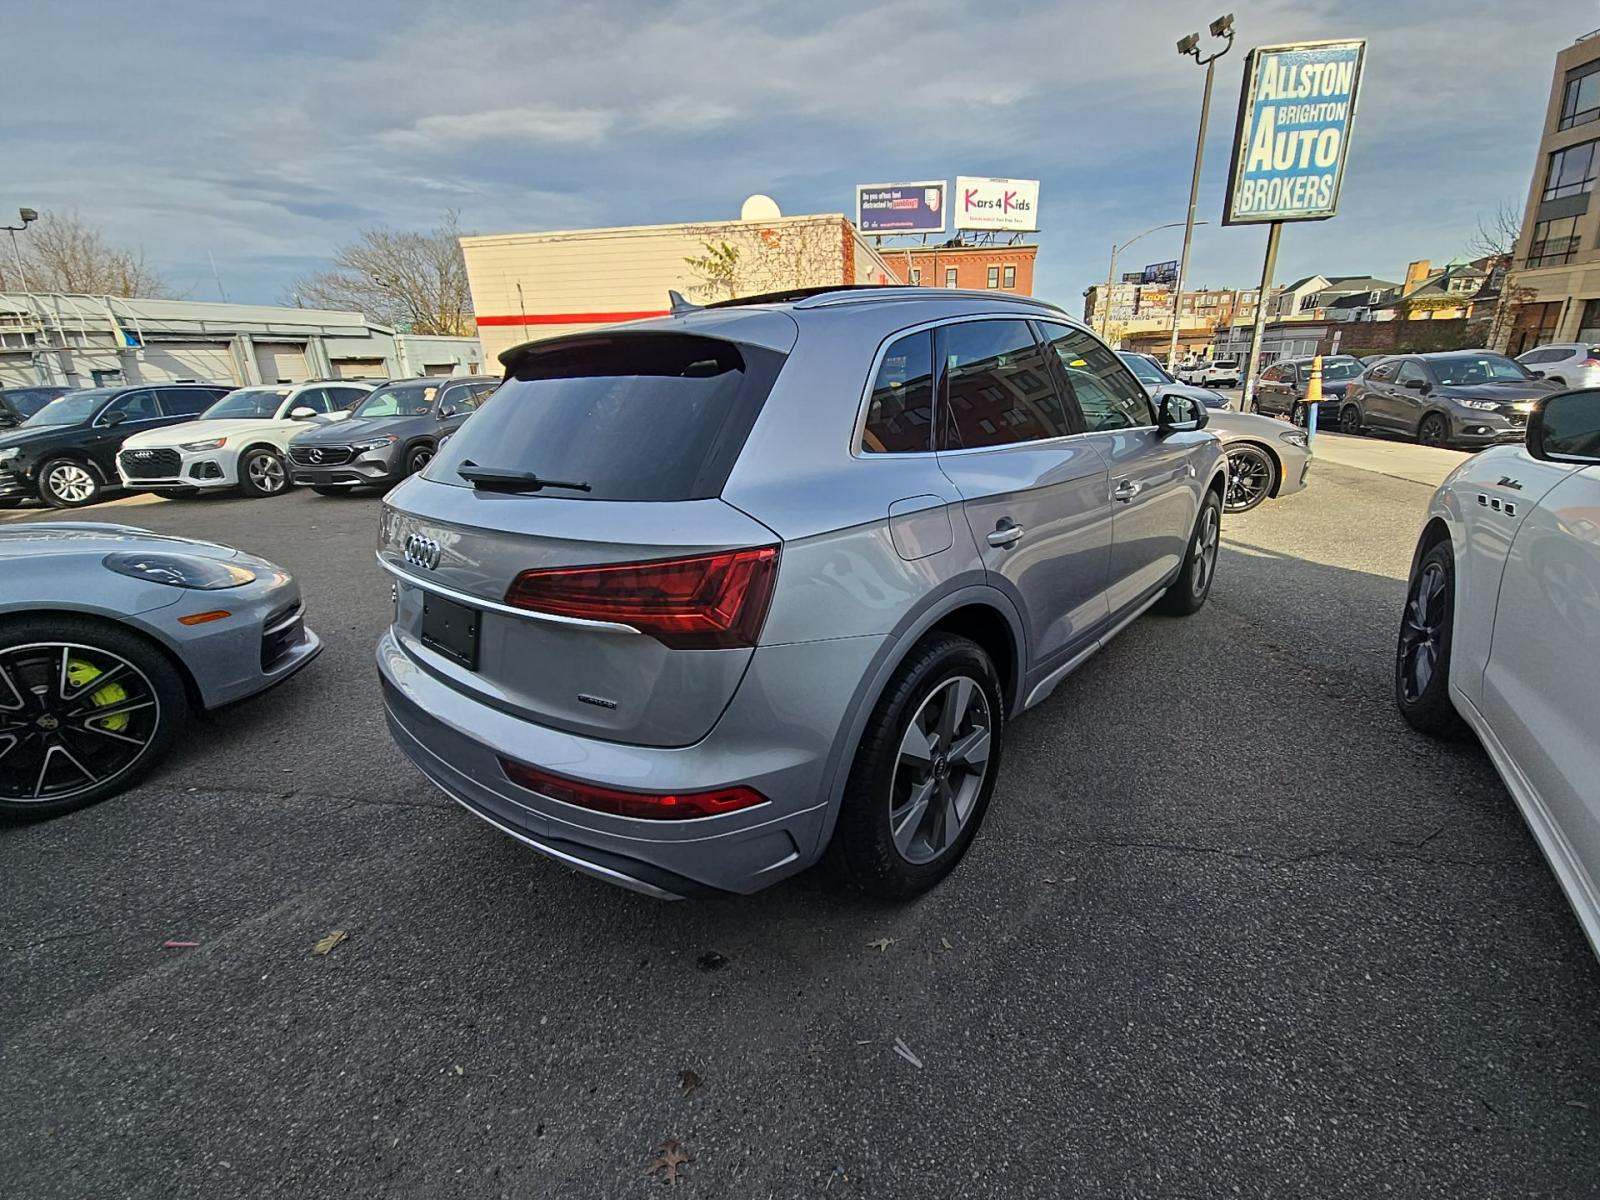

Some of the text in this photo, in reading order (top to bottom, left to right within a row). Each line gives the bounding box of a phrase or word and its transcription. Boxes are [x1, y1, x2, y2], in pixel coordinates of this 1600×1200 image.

[1257, 56, 1354, 101] ALLSTON
[1277, 102, 1347, 125] BRIGHTON
[1247, 105, 1341, 173] AUTO
[1240, 174, 1333, 211] BROKERS
